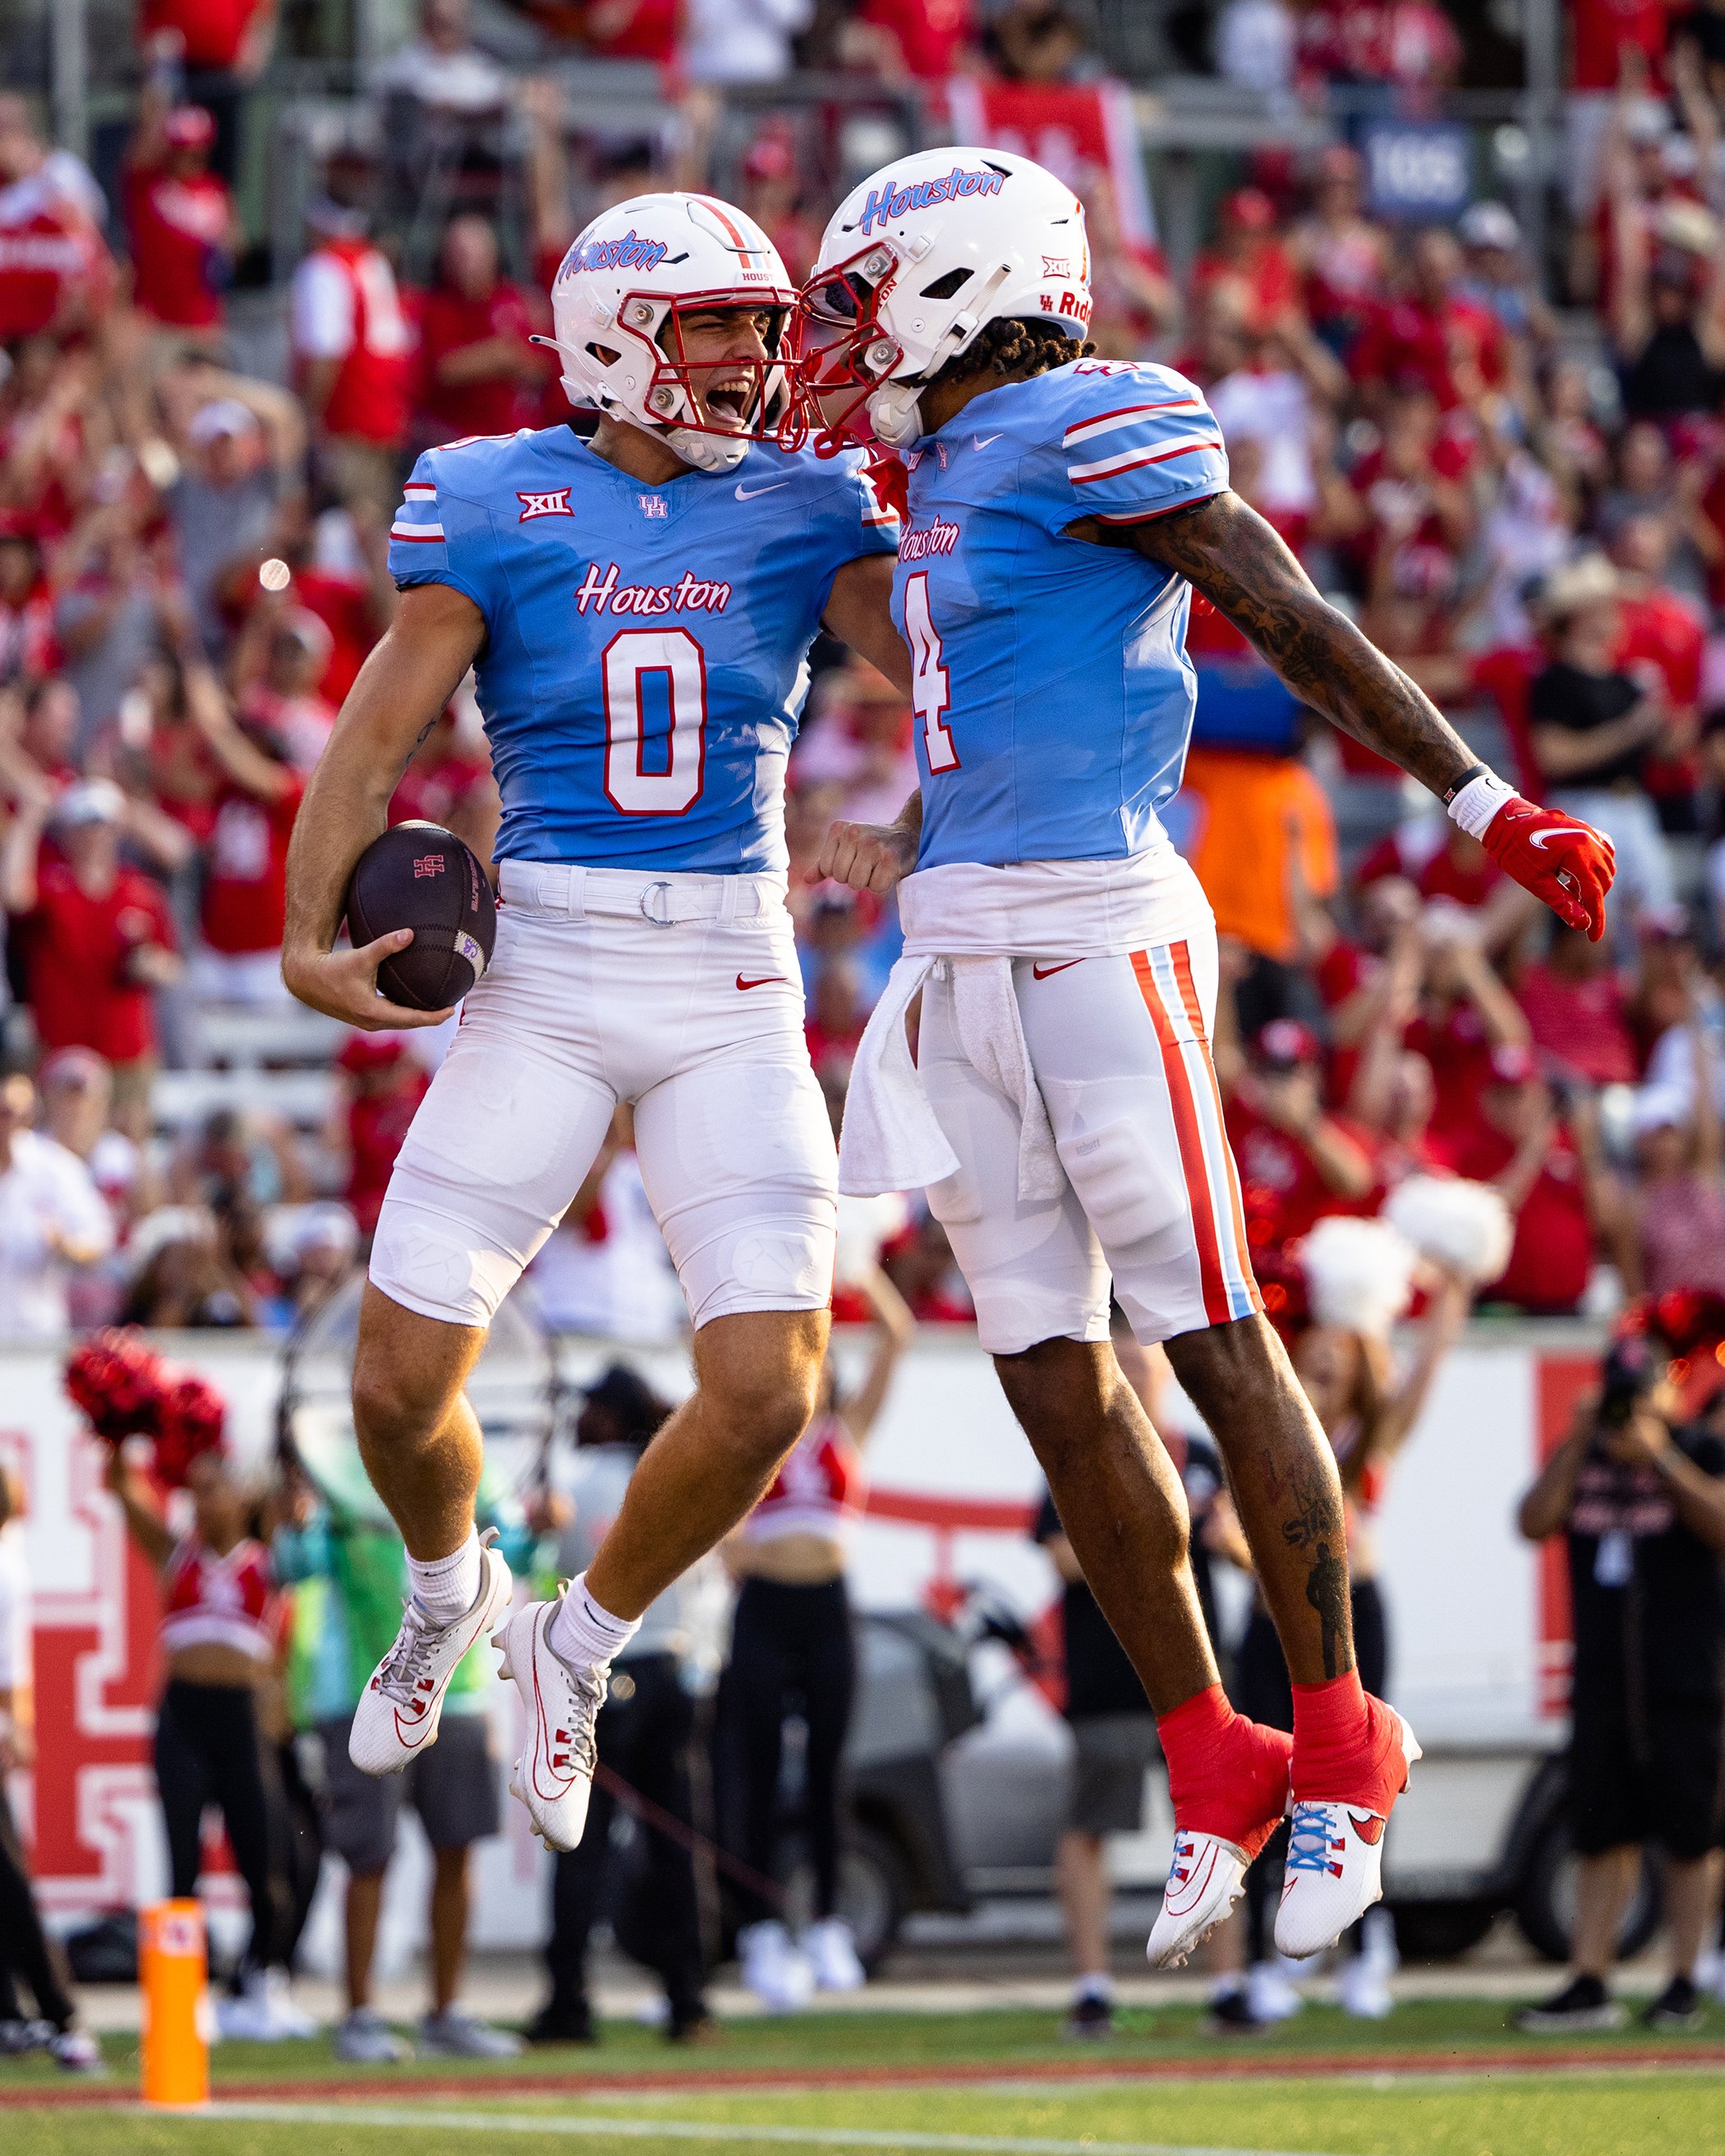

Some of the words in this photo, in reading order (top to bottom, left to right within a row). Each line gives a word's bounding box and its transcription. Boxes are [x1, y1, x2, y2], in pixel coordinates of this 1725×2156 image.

[859, 167, 1006, 236] Houston
[558, 229, 667, 284] Houston
[518, 488, 574, 522] XII
[898, 514, 959, 565] Houston
[574, 561, 732, 616] Houston
[904, 570, 962, 776] 4
[601, 626, 709, 816] 0
